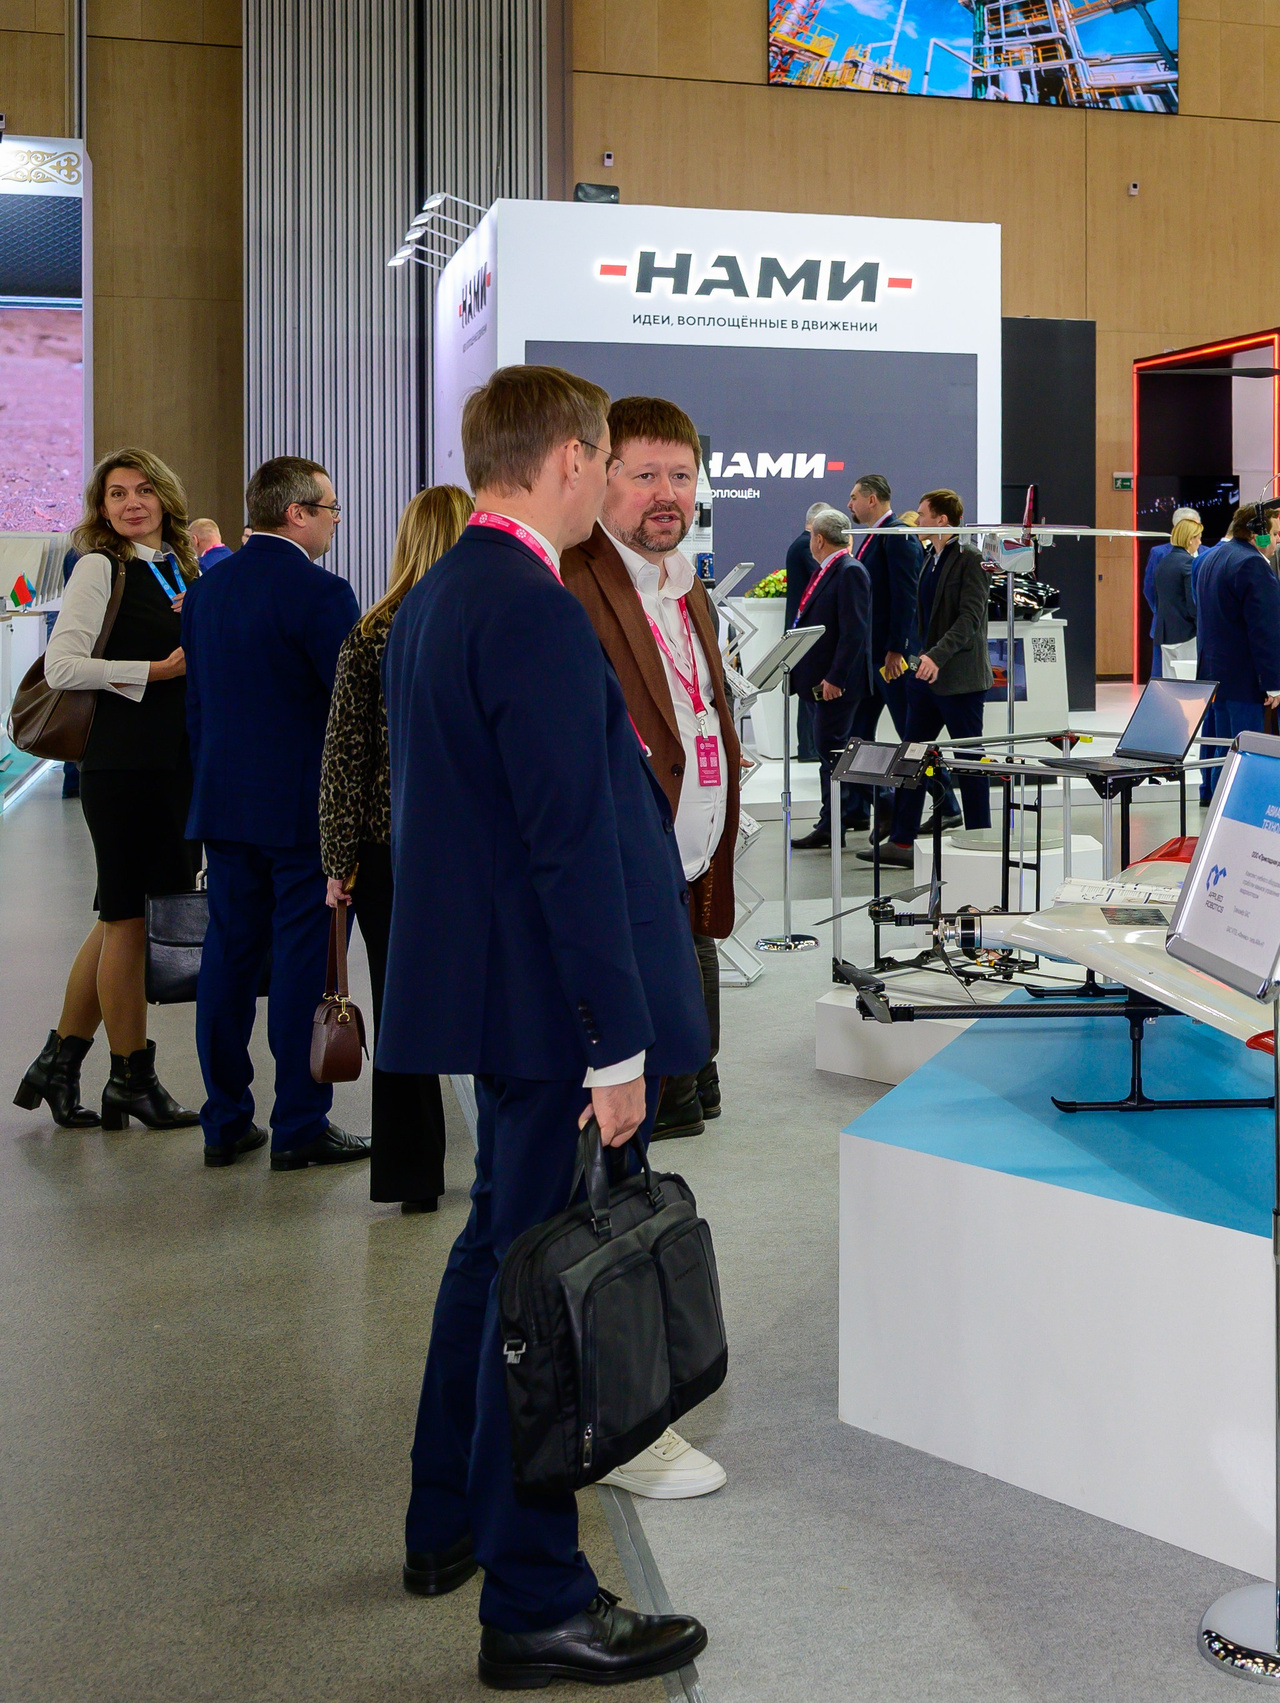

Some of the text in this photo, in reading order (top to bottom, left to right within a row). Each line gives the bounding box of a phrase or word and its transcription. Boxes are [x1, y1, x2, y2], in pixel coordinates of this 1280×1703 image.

[635, 250, 881, 303] НАМИ
[632, 313, 879, 332] ИДЕИ, ВОПЛОЩЁННЫЕ В ДВИЖЕНИИ
[1208, 891, 1224, 902] APPLIED
[1206, 900, 1224, 913] ROBOTICS
